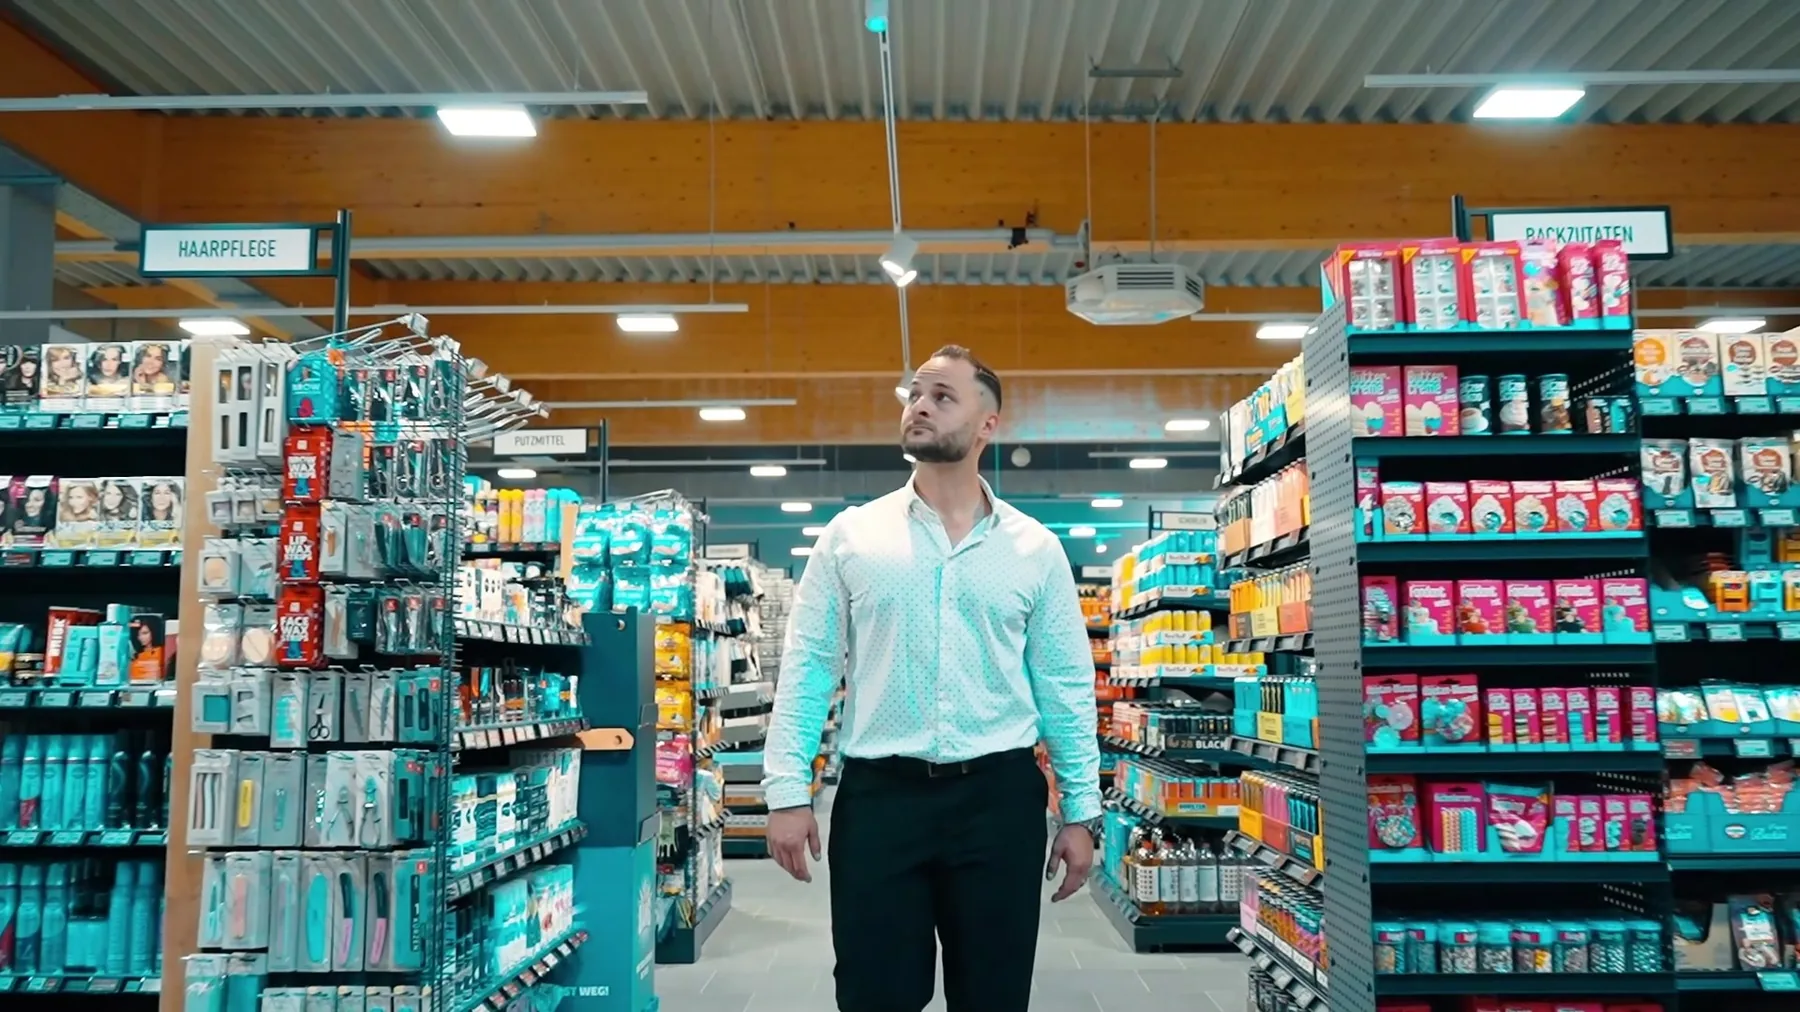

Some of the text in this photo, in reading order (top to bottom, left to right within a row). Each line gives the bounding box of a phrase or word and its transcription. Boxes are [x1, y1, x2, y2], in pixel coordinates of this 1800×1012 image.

[178, 239, 278, 257] HAARPFLEGE
[514, 435, 566, 447] PUTZMITTEL
[280, 616, 309, 627] FACE
[579, 986, 609, 997] WEG!
